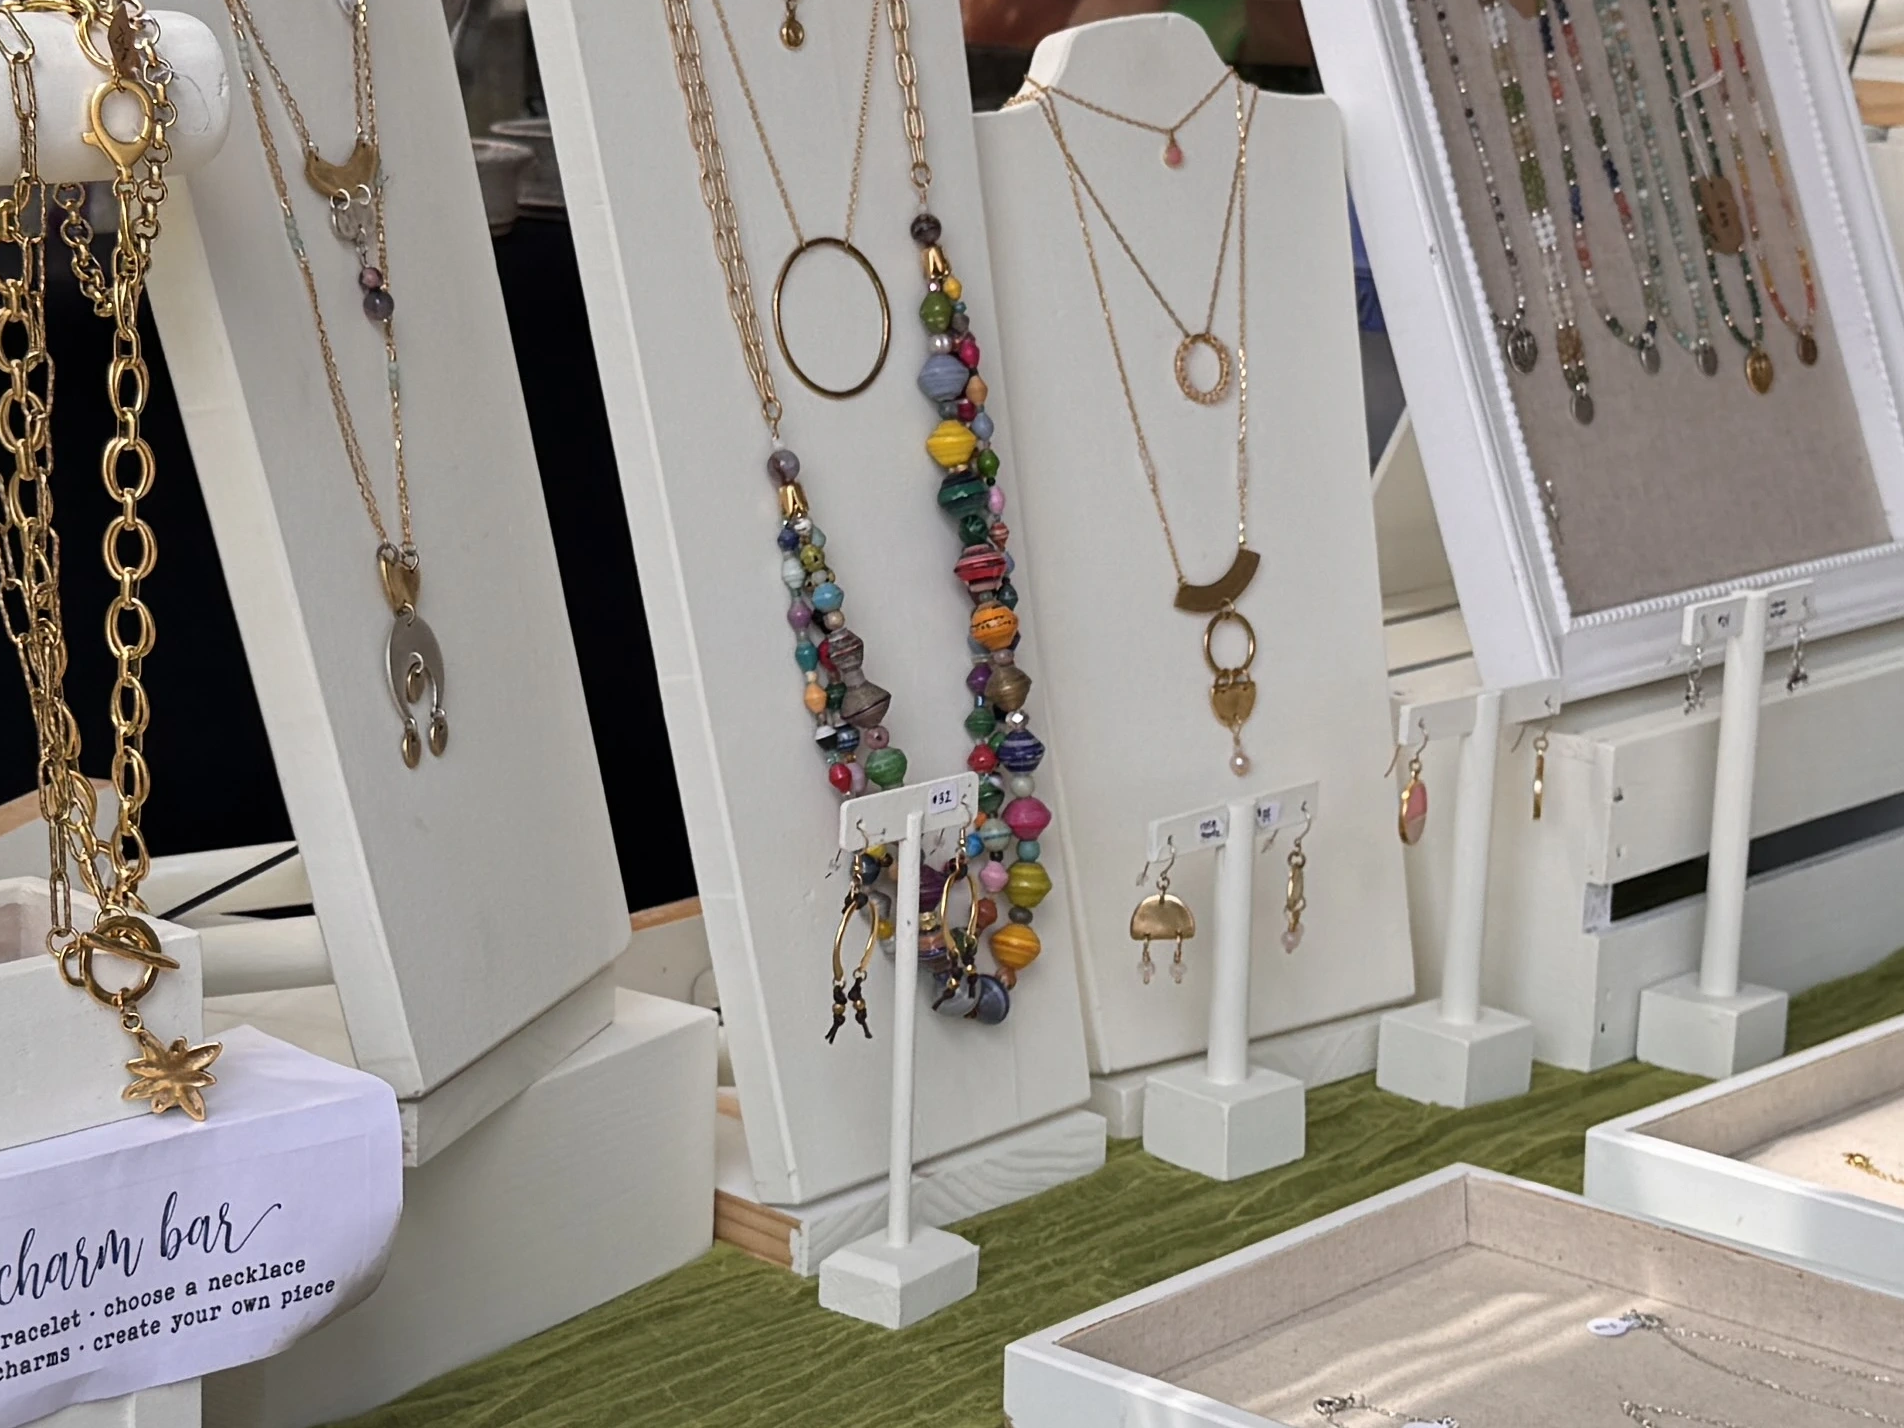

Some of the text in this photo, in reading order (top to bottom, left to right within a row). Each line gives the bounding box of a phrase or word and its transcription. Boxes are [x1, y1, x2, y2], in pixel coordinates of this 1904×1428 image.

[160, 1191, 281, 1258] bar
[92, 1319, 161, 1352] create
[170, 1305, 222, 1335] your
[231, 1293, 271, 1316] own
[281, 1277, 337, 1313] piece
[103, 1282, 175, 1319] choose
[185, 1280, 198, 1297] a
[208, 1258, 306, 1292] necklace
